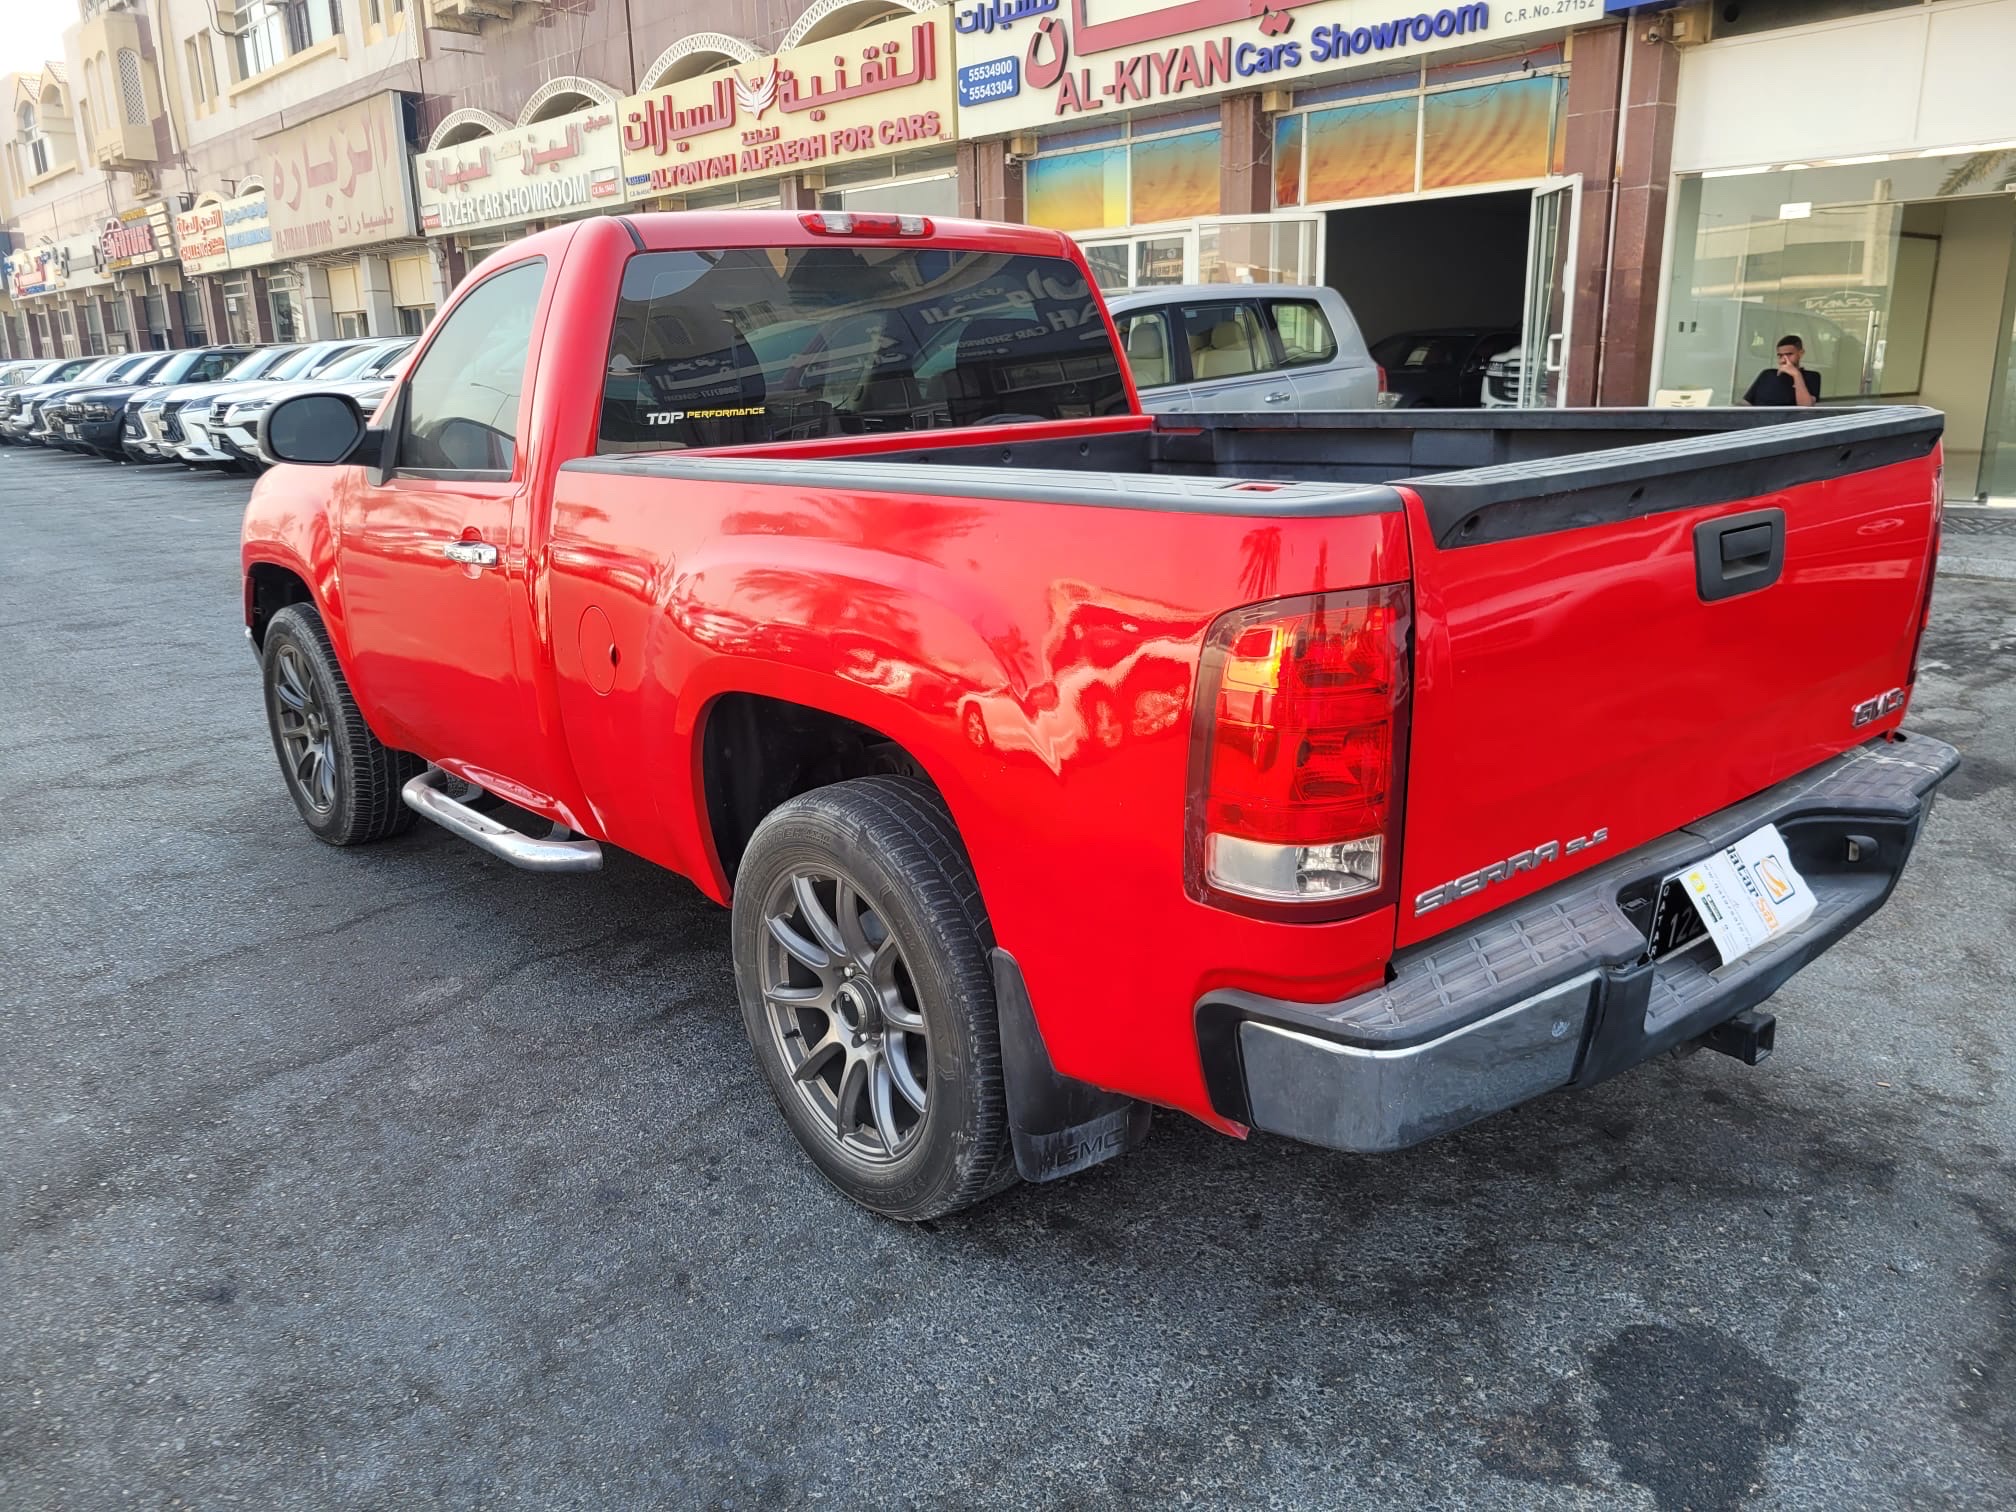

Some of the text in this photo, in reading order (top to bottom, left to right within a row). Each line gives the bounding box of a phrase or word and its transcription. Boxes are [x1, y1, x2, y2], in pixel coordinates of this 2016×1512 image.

[778, 21, 936, 121] التقنية
[968, 60, 1012, 82] 55534900
[1055, 36, 1231, 116] AL-KIYAN
[1235, 41, 1301, 76] Cars
[1310, 1, 1489, 62] Showroom
[623, 77, 736, 156] للسيارات
[969, 81, 1013, 101] 55543304
[651, 154, 736, 190] ALTQNYAH
[740, 134, 826, 172] ALFAEQH
[830, 125, 875, 155] FOR
[878, 111, 941, 145] CARS
[440, 197, 476, 228] LAZER
[477, 190, 501, 221] CAR
[503, 173, 587, 216] SHOWROOM
[113, 224, 153, 260] FUTURE
[646, 406, 766, 425] TOP PERFORMANCE
[1414, 827, 1609, 918] SIERRA SLE
[1650, 884, 1671, 956] QATAR
[1055, 1126, 1127, 1168] GMC
